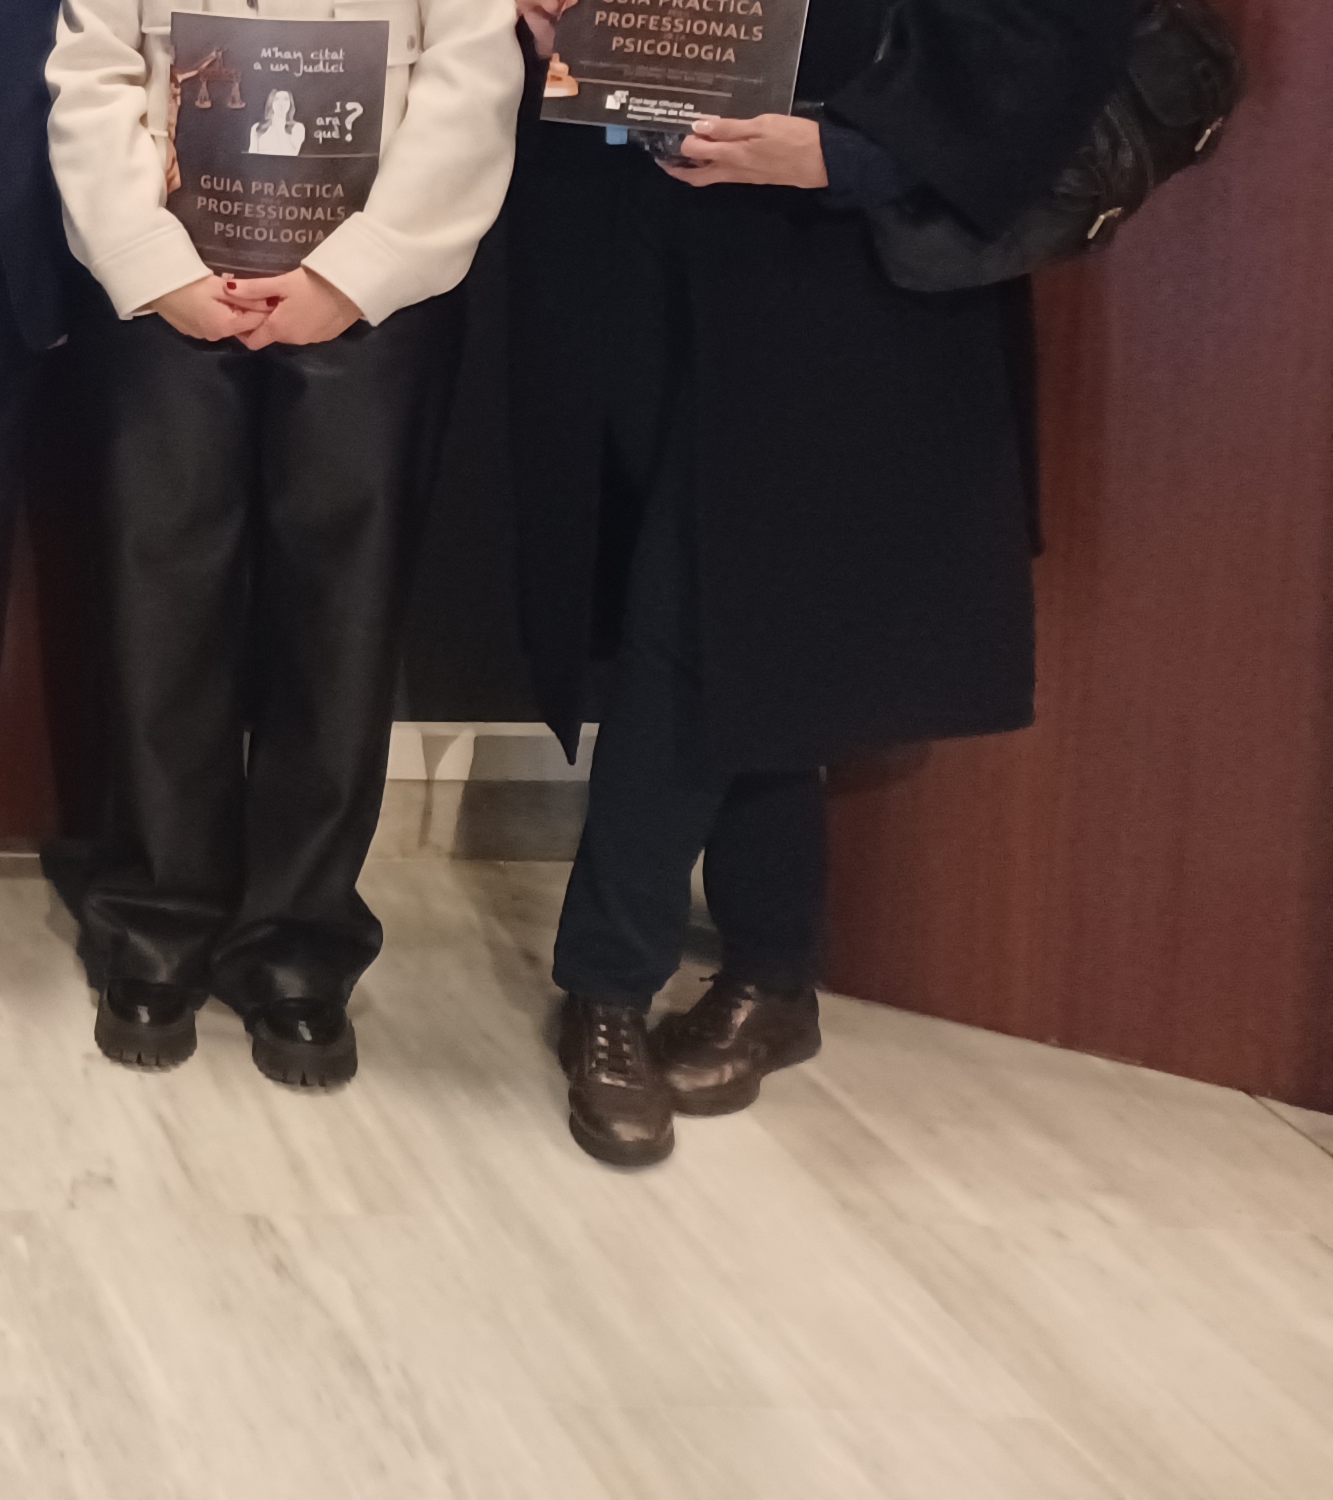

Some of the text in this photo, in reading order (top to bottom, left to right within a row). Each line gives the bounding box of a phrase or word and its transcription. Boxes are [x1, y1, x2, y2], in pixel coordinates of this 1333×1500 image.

[595, 11, 763, 41] PROFESSIONALS
[311, 48, 344, 60] citat
[612, 36, 735, 63] PSICOLOGIA
[253, 62, 262, 70] a
[270, 63, 289, 72] un
[316, 117, 340, 126] ara
[200, 175, 345, 198] GUIA PRÀCTICA
[197, 196, 346, 221] PROFESSIONALS
[214, 222, 325, 244] PSICOLOGIA
